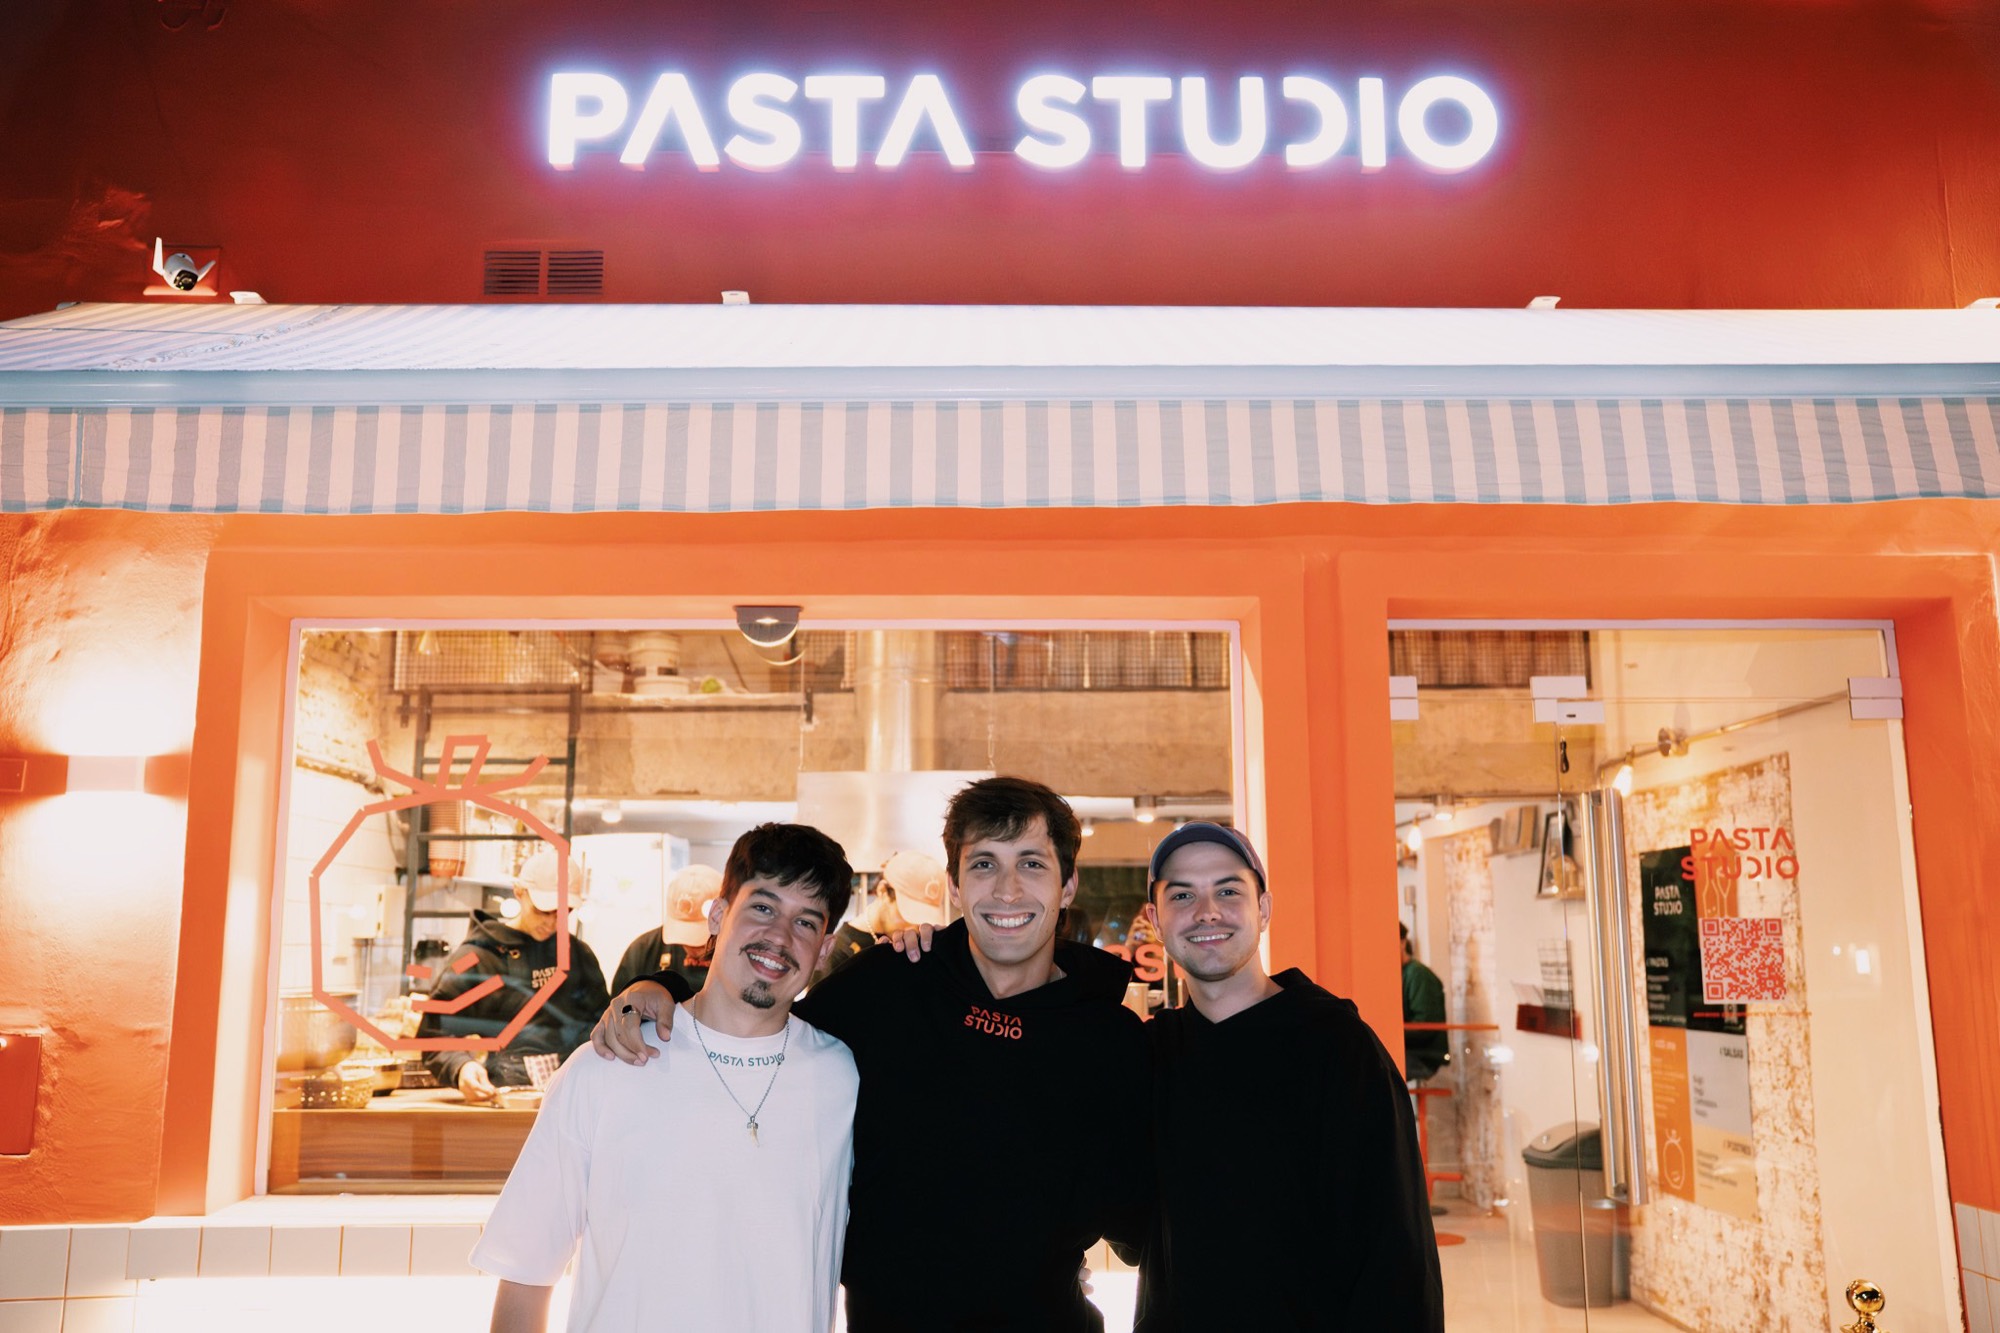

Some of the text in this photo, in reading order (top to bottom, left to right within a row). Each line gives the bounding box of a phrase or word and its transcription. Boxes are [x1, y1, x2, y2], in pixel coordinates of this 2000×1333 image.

[549, 73, 1498, 170] PASTA STUDIO
[1690, 827, 1794, 851] PASTA
[1680, 855, 1800, 881] STUDIO
[1654, 885, 1681, 900] PASTA
[1653, 901, 1683, 916] STUDIO
[532, 966, 557, 980] PAST
[971, 1005, 1022, 1026] PASTA
[964, 1014, 1023, 1040] STUDIO
[708, 1051, 785, 1067] PASTA STUDIO
